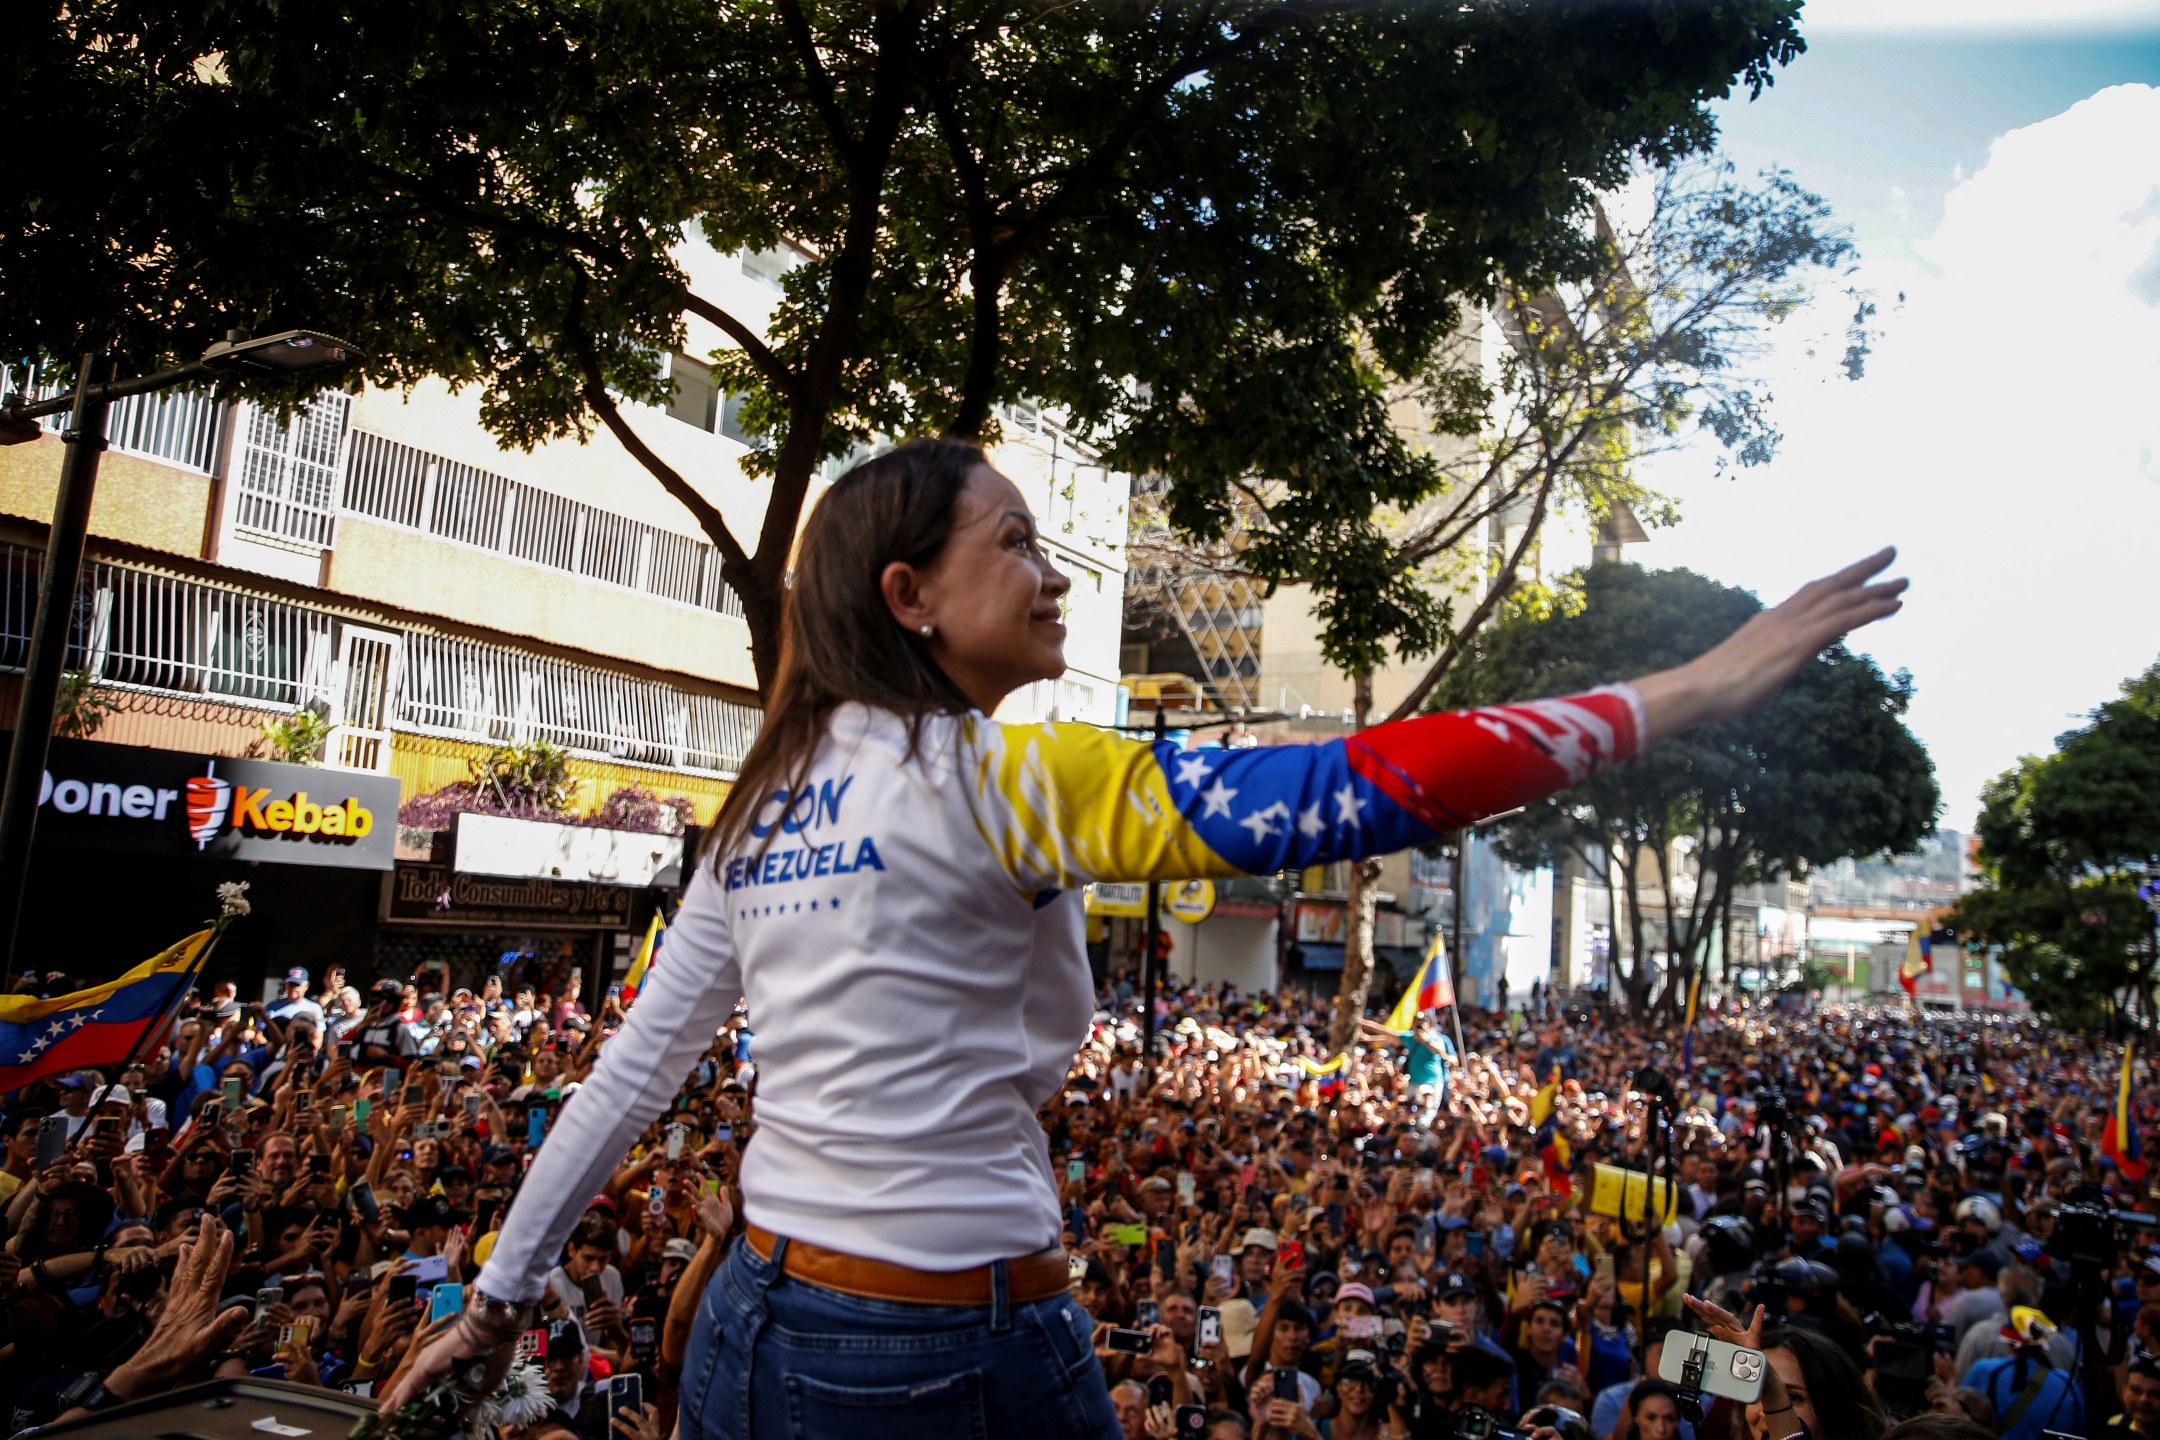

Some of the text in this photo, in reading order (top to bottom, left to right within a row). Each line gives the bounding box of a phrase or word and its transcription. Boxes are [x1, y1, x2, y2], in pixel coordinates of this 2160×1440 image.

[231, 785, 374, 838] Kebab
[751, 775, 855, 838] CON
[725, 837, 886, 890] ENEZUELA
[453, 874, 571, 909] Consumibles
[568, 889, 585, 914] y
